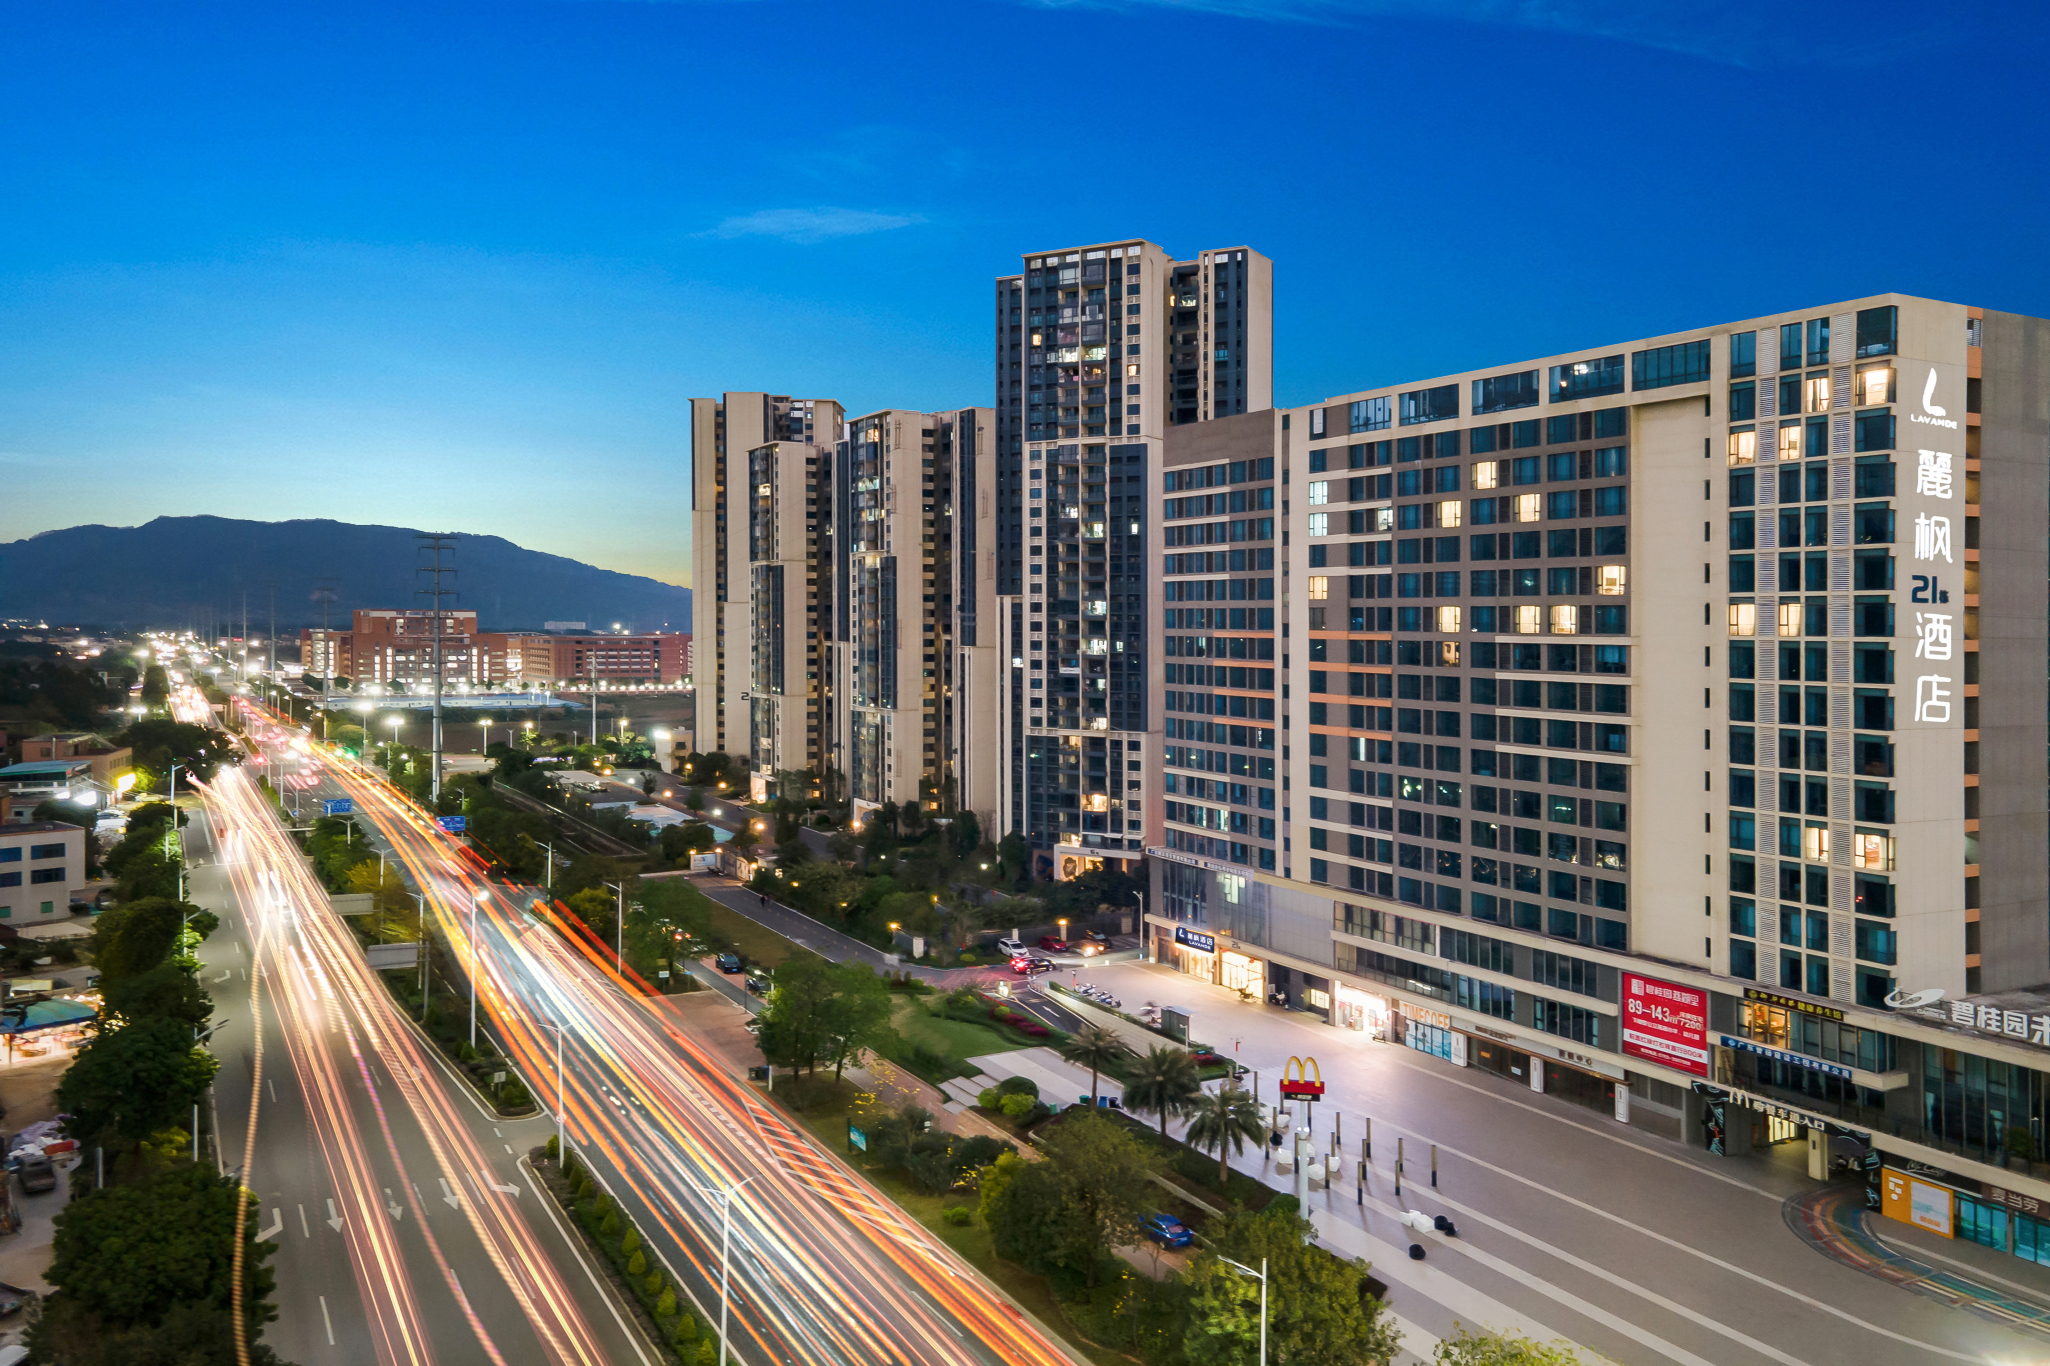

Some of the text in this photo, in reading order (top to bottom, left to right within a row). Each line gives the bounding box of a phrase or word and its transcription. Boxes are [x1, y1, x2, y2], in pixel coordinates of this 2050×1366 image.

[1911, 414, 1957, 429] LAVANDE
[1188, 940, 1211, 950] LAVANDE
[1991, 1187, 2039, 1213] 麦当劳
